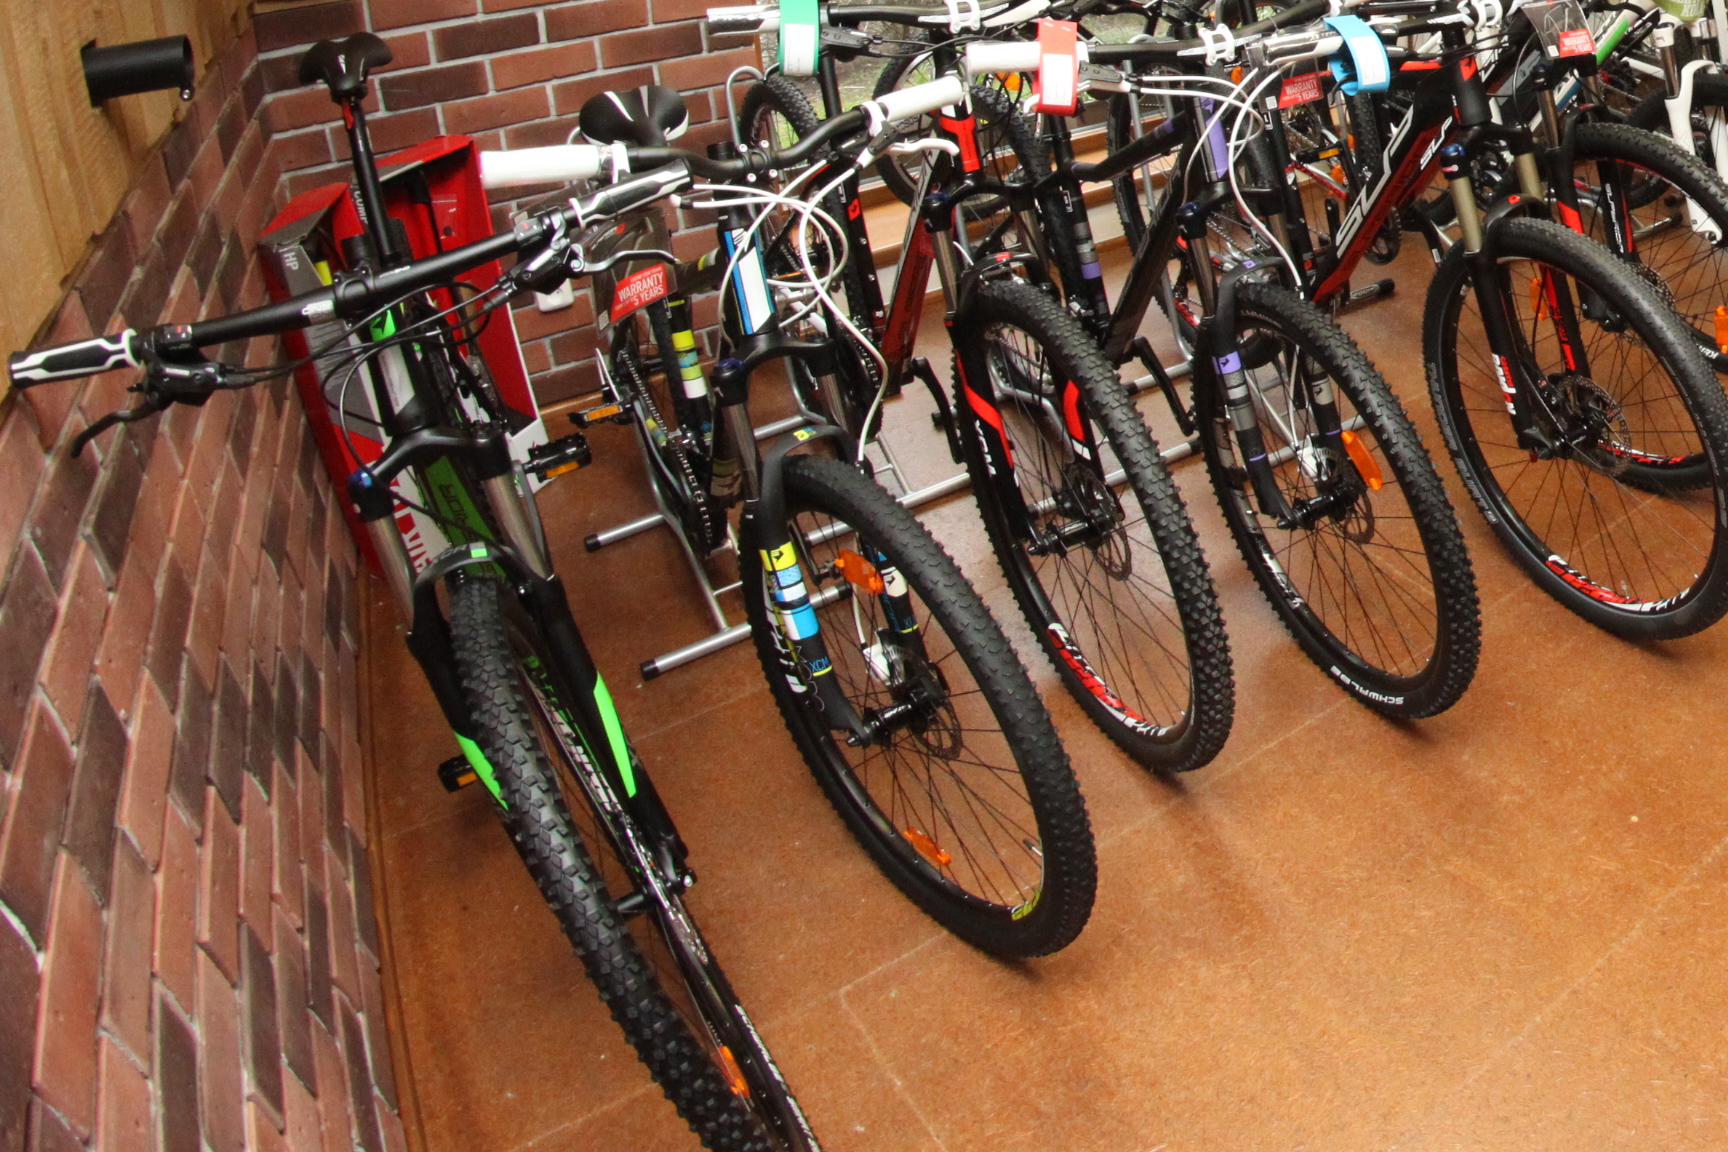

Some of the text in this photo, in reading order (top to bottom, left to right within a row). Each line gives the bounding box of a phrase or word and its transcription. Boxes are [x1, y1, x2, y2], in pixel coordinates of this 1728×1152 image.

[1285, 79, 1318, 96] WARRANTY
[1302, 89, 1319, 100] YEARS
[283, 251, 300, 271] HP
[618, 271, 664, 302] WARRANTY
[633, 284, 664, 306] 5 YEARS
[810, 657, 830, 673] XCM
[1330, 665, 1404, 705] SCHWALBE
